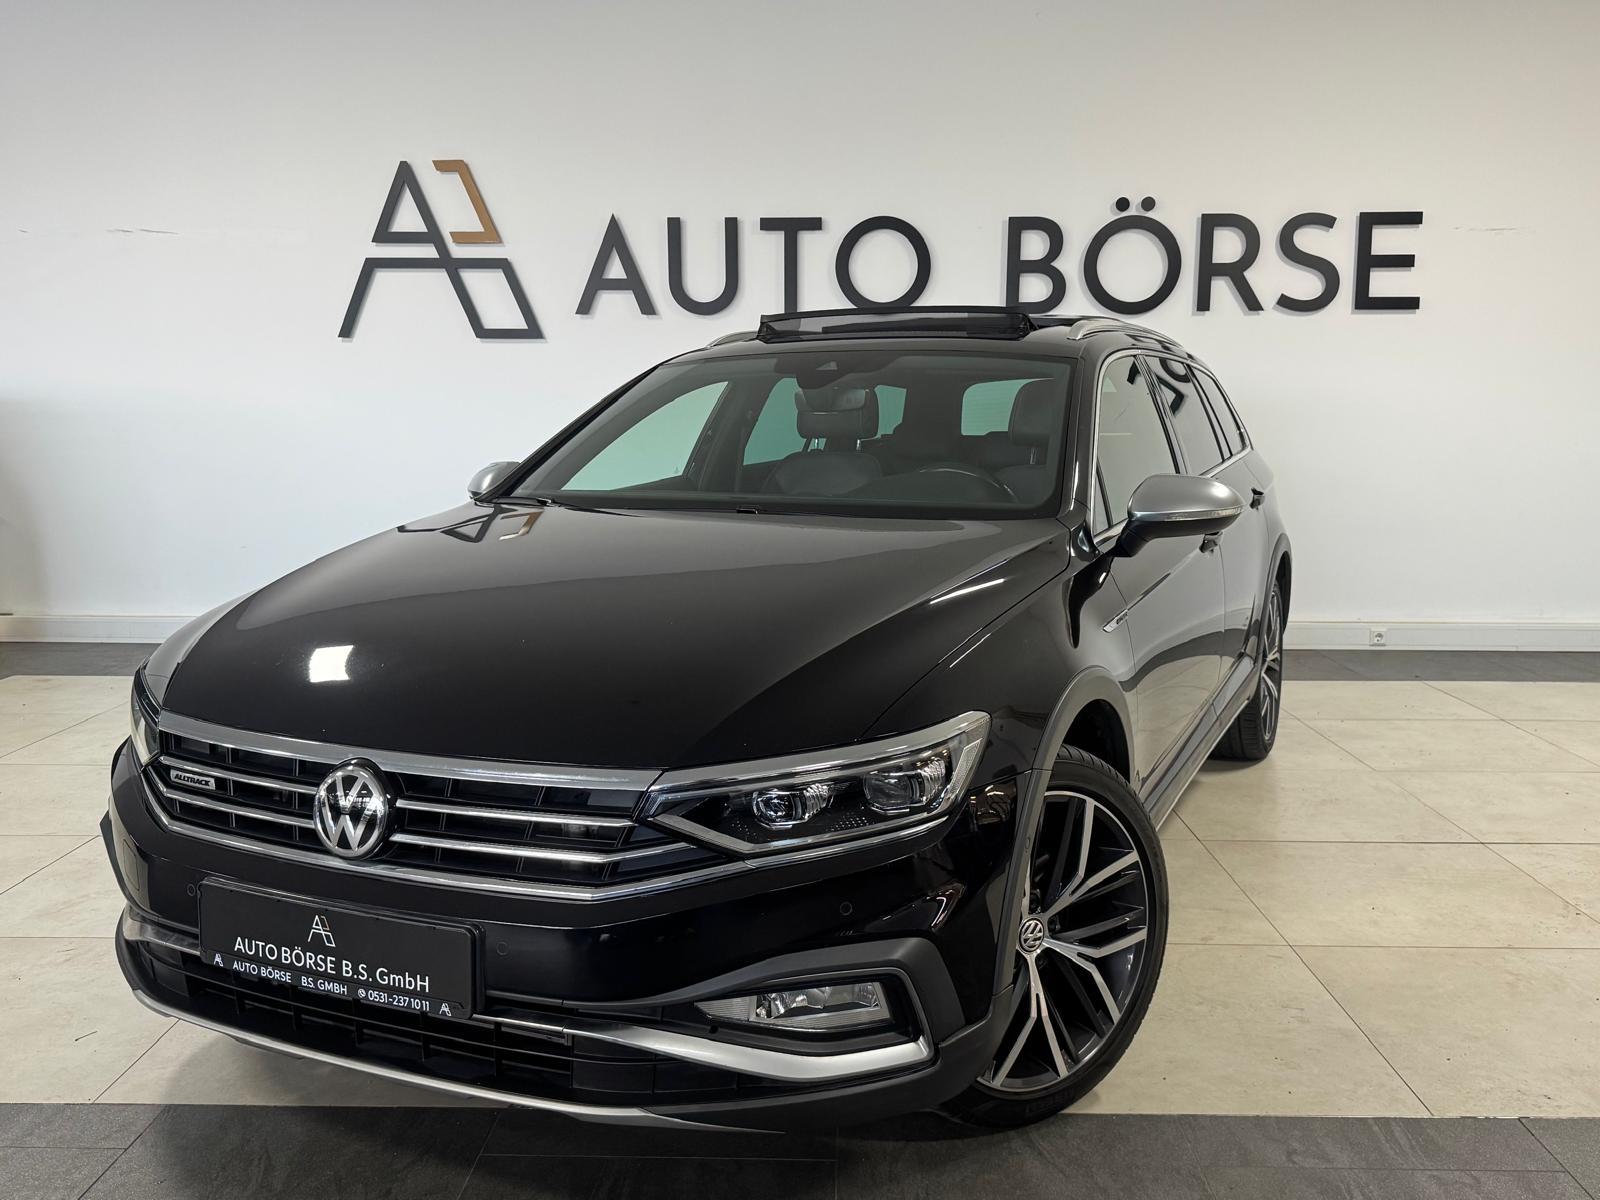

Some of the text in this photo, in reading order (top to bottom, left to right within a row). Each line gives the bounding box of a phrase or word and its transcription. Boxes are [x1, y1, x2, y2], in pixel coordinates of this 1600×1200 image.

[575, 196, 1424, 316] AUTO BÖRSE
[174, 773, 211, 787] ALLTRACK
[232, 960, 258, 975] AUTO
[260, 966, 292, 983] BÖRSE
[317, 980, 348, 995] GMBH
[234, 936, 429, 993] AUTO BÖRSE B.S. GmbH
